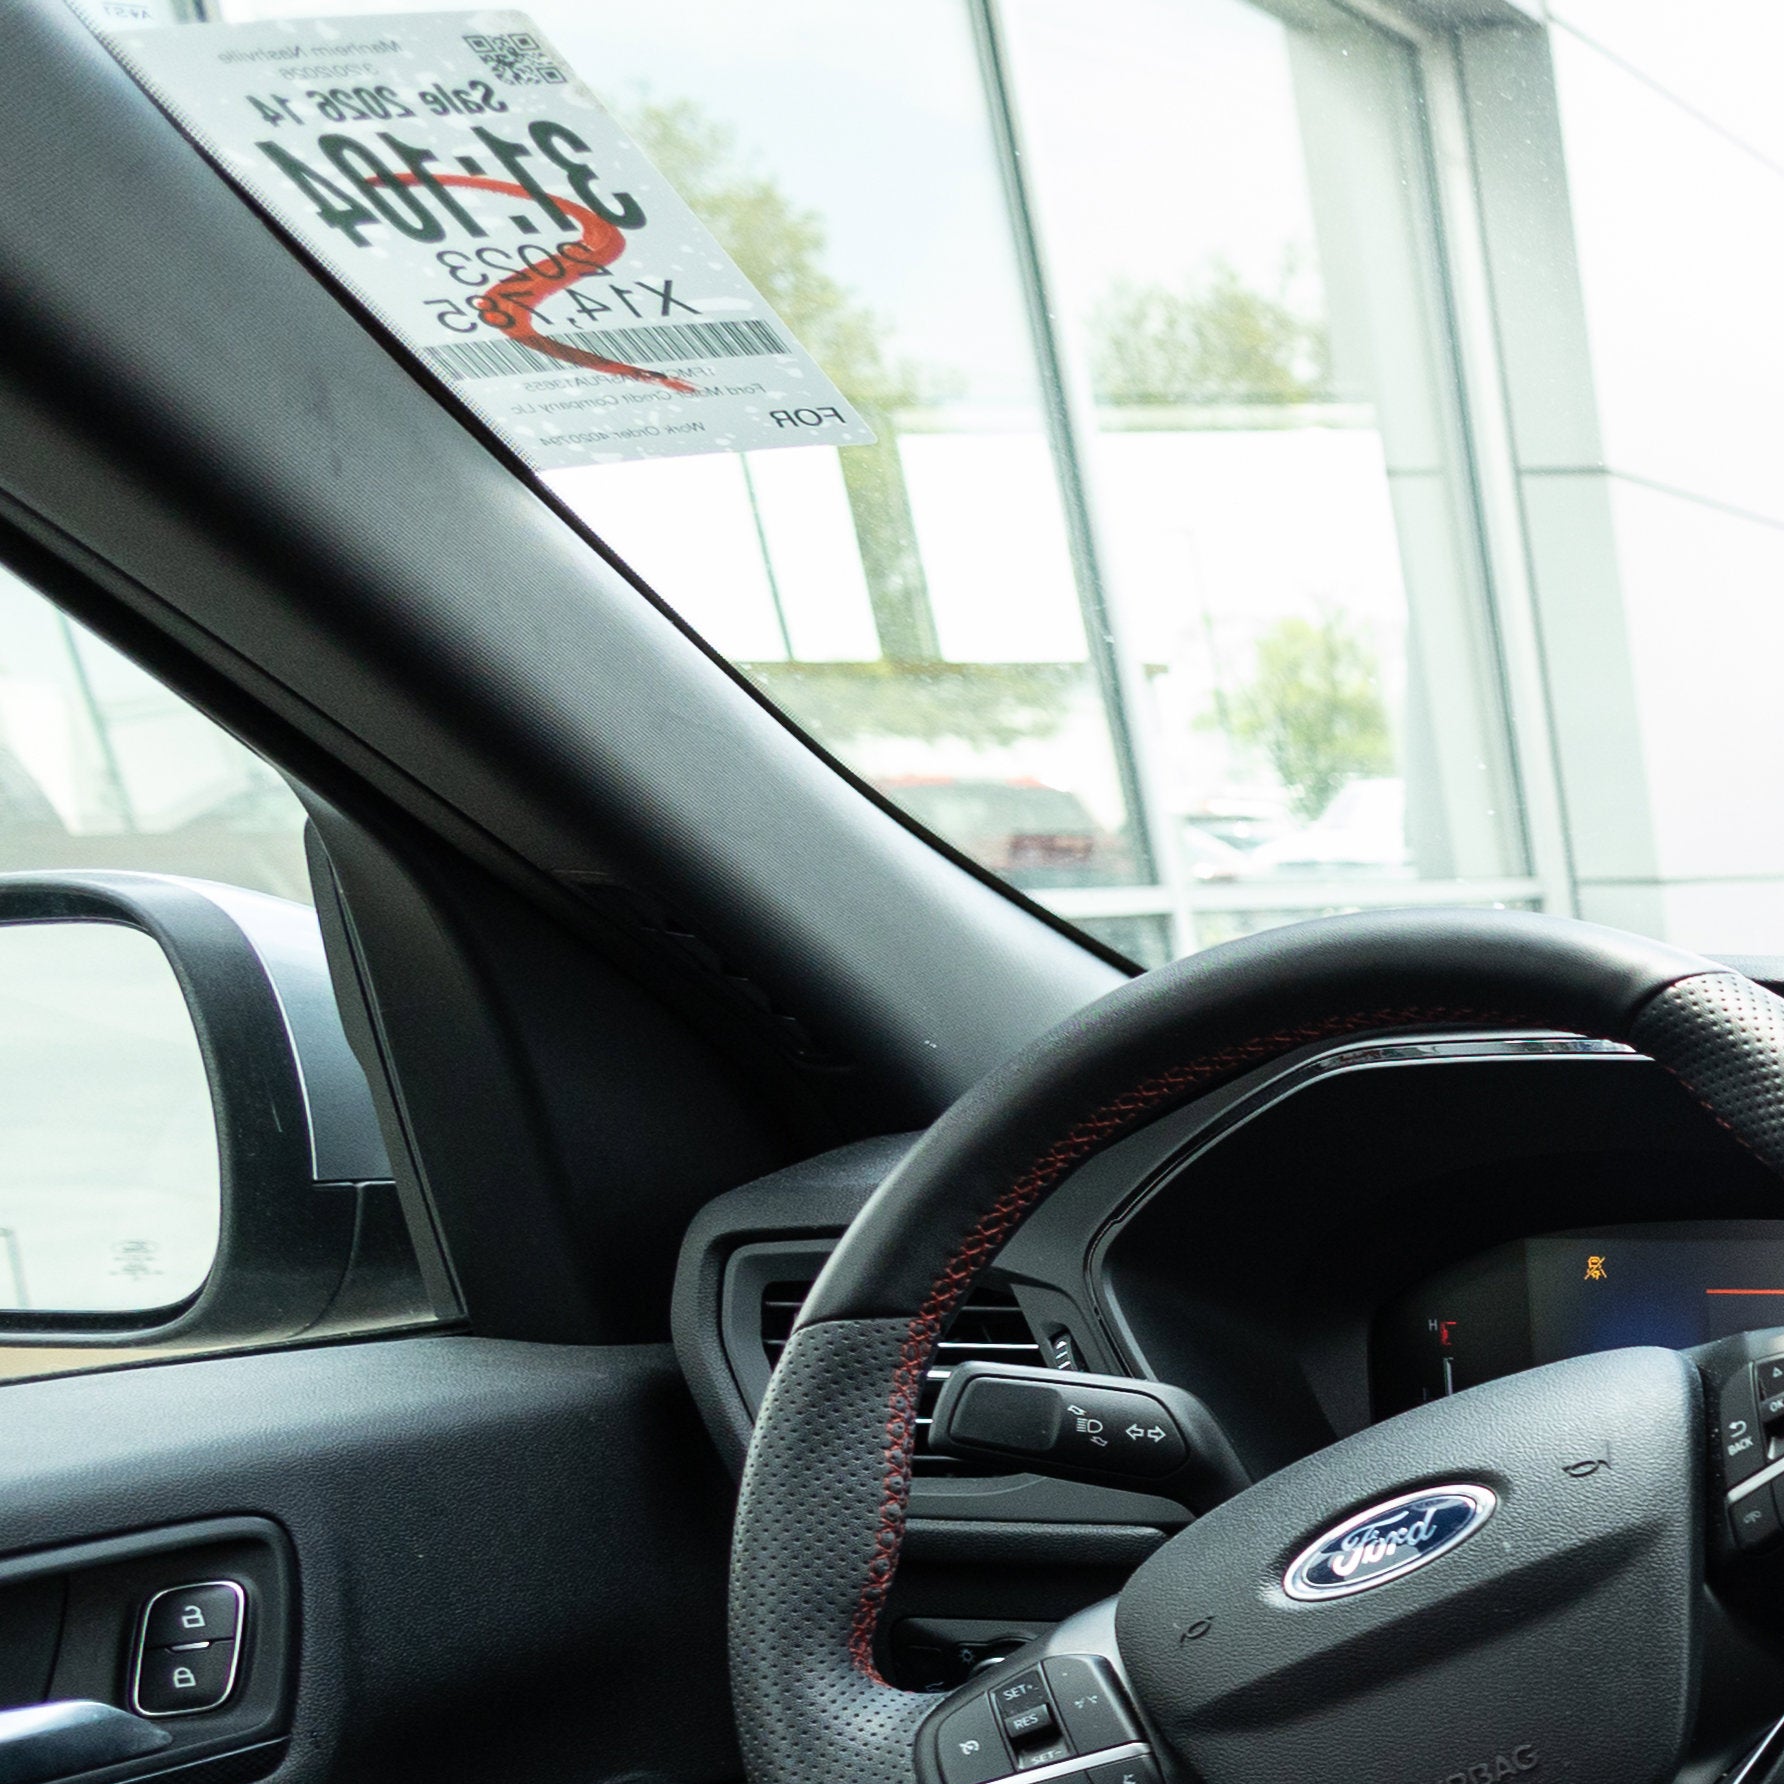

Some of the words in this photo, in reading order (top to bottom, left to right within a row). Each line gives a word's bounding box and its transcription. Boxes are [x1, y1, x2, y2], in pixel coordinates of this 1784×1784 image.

[1427, 1318, 1439, 1332] H
[1727, 1436, 1754, 1457] BACK
[1320, 1507, 1438, 1577] Ford
[1013, 1714, 1039, 1730] RES
